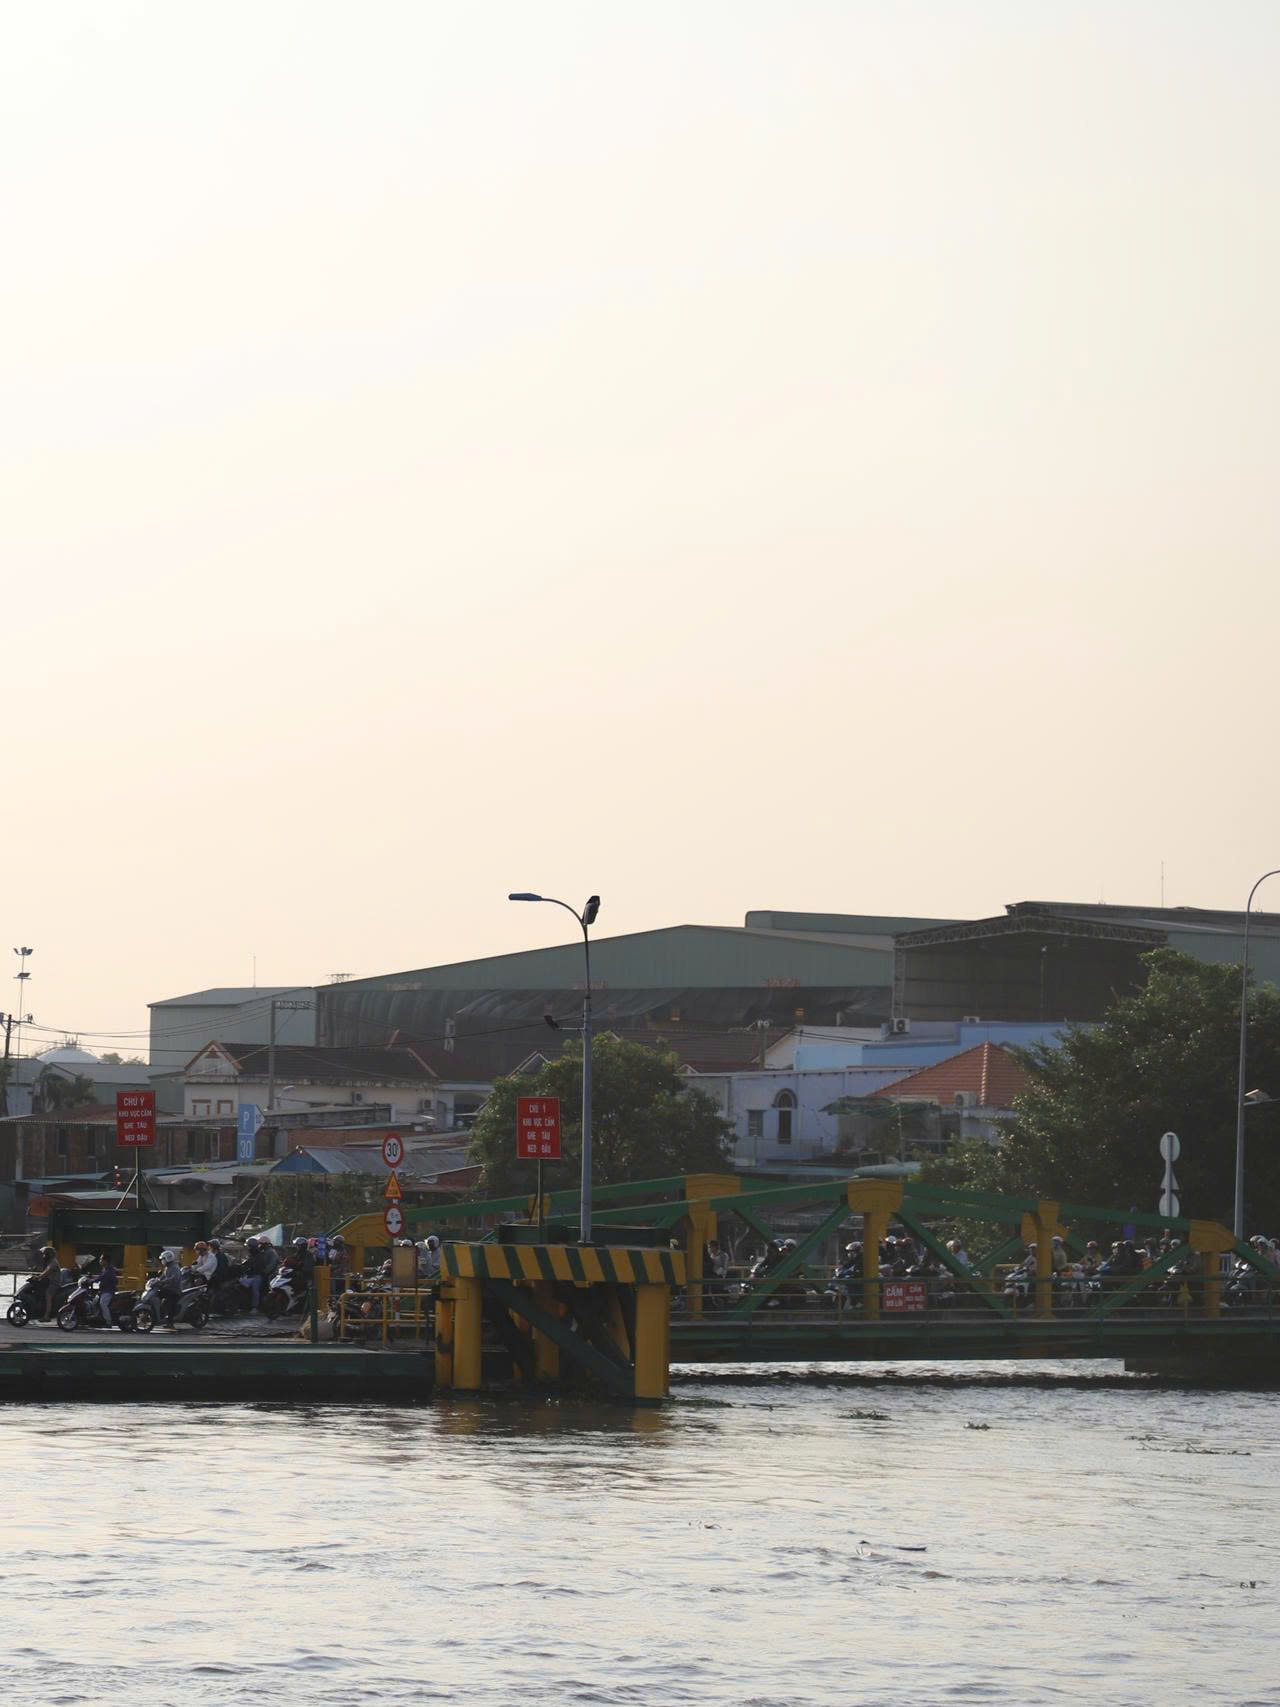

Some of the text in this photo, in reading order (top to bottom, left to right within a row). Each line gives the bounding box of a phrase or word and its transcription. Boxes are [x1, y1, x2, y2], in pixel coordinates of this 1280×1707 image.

[243, 1111, 250, 1129] P
[239, 1140, 253, 1159] 30
[386, 1142, 399, 1157] 30
